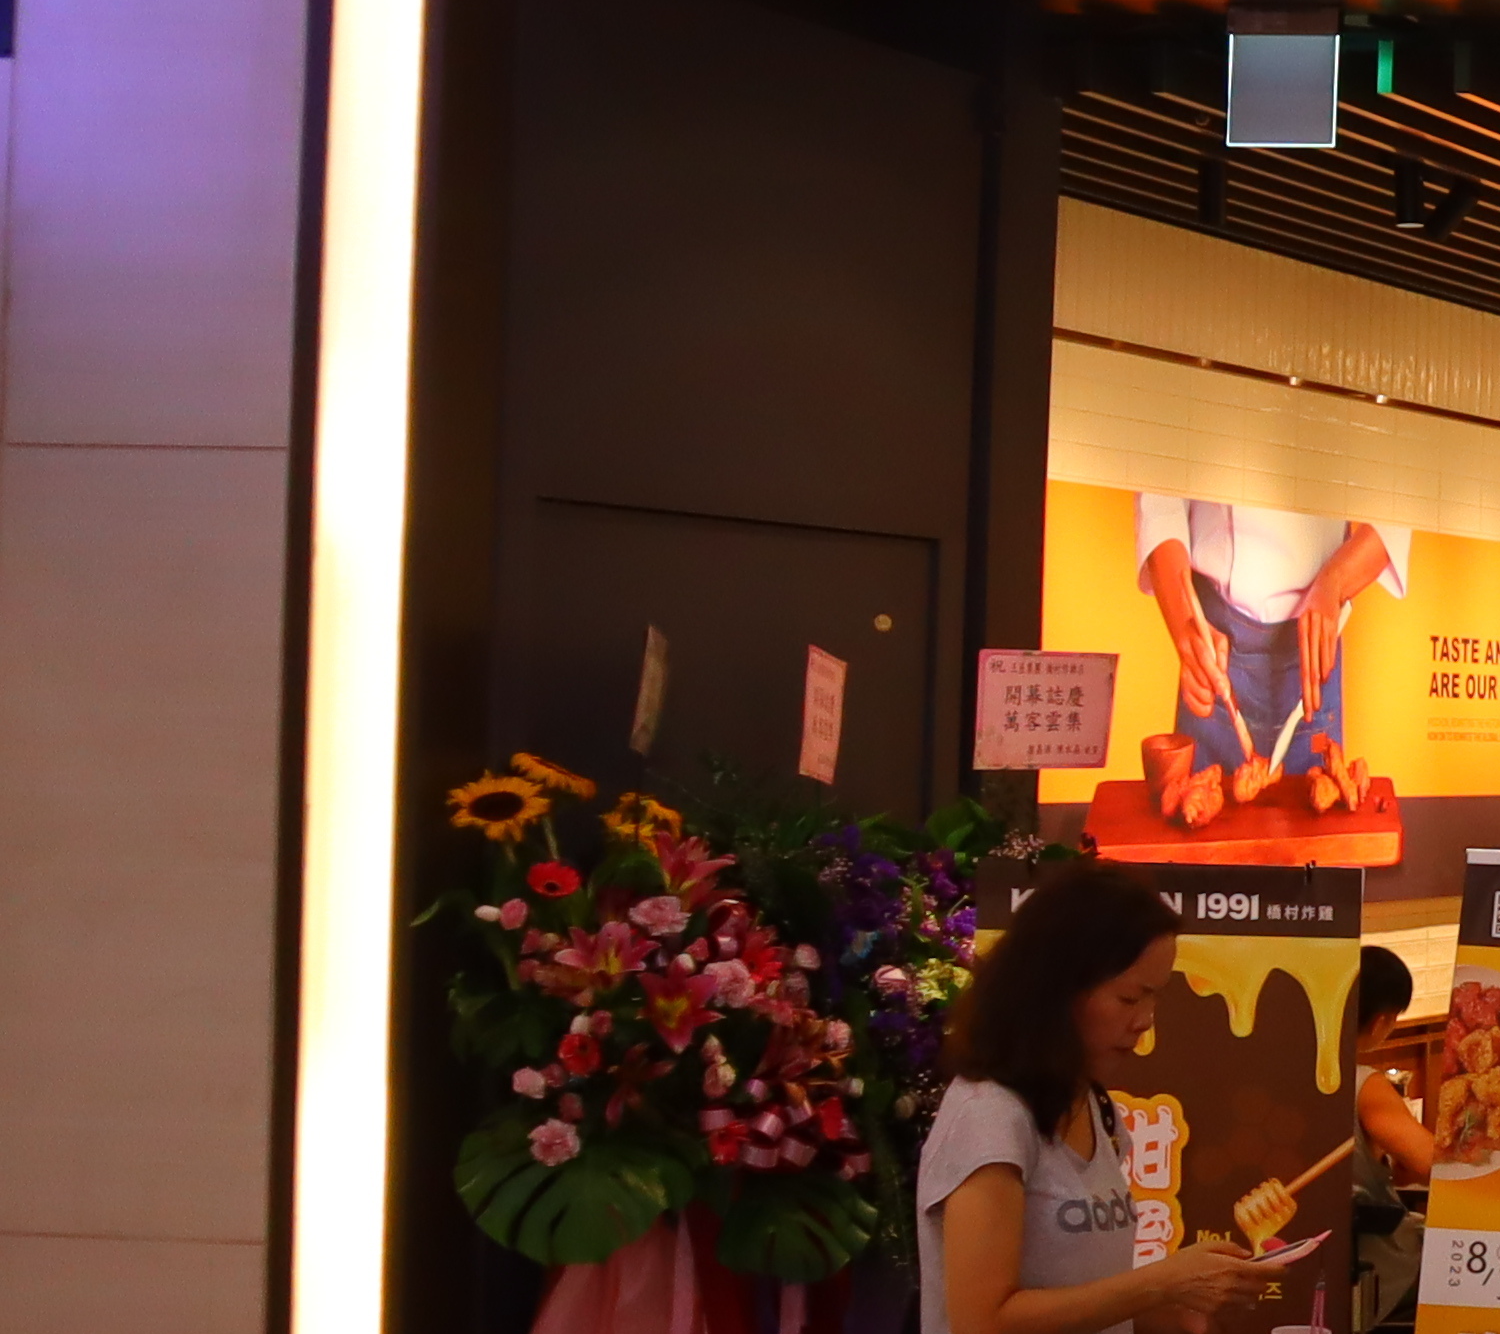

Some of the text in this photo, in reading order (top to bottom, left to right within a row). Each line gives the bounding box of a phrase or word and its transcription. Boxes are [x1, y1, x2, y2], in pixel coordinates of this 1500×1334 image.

[1429, 635, 1480, 663] TASTE
[1004, 684, 1085, 708] 開幕誌慶
[1429, 672, 1460, 698] ARE
[1465, 674, 1497, 700] OUR
[1003, 710, 1083, 733] 萬客雲集
[1196, 892, 1260, 920] 1991
[1265, 903, 1335, 922] 橋村炸雞
